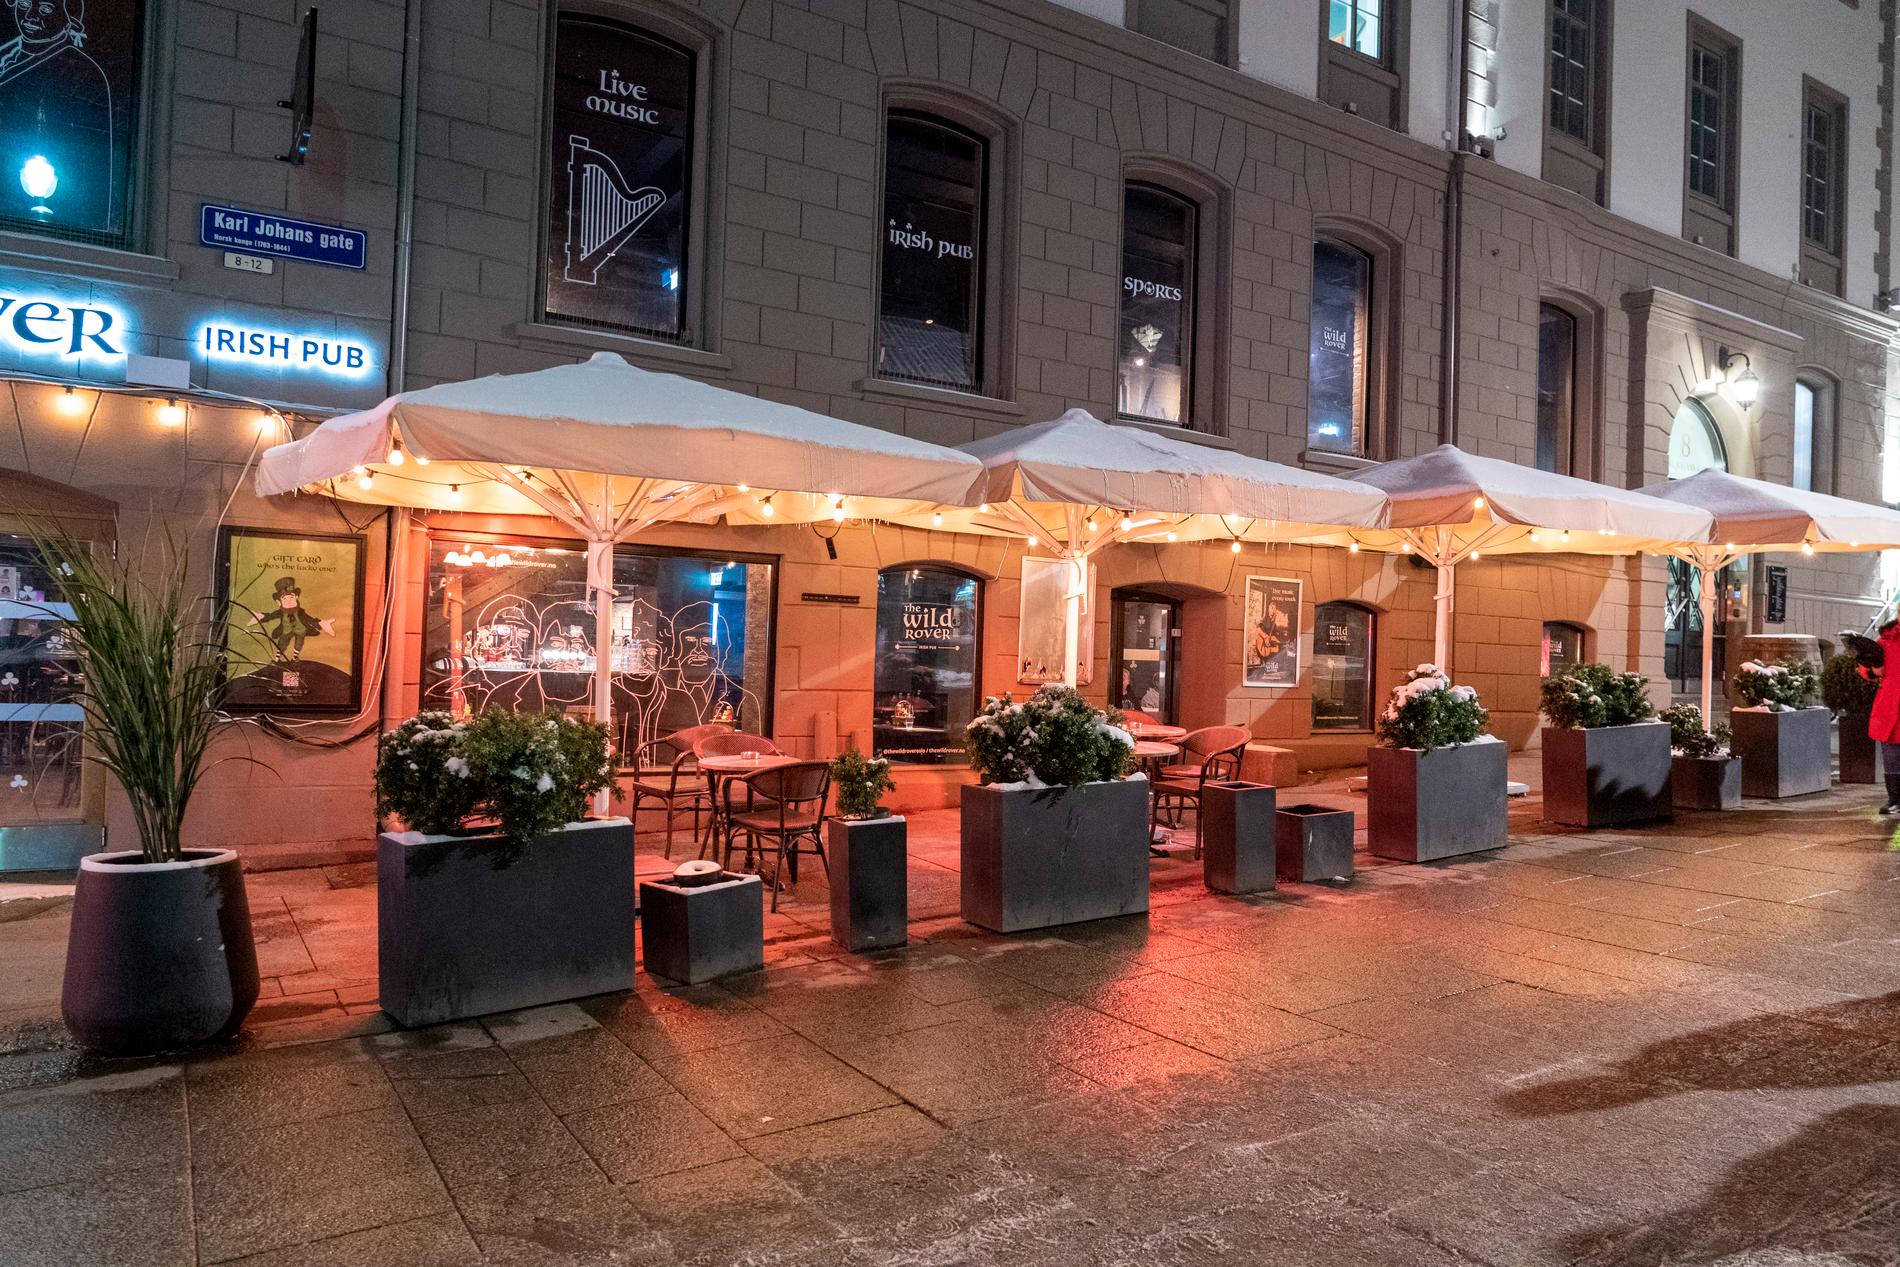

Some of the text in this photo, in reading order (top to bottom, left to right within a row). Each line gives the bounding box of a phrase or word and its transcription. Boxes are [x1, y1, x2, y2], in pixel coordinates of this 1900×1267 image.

[600, 69, 648, 101] Live
[586, 96, 659, 125] music
[214, 212, 354, 250] Karl Johans gate
[214, 233, 232, 242] Norsk
[205, 327, 364, 369] IRISH PUB
[1682, 434, 1690, 457] 8
[273, 555, 322, 564] GIFT CARD
